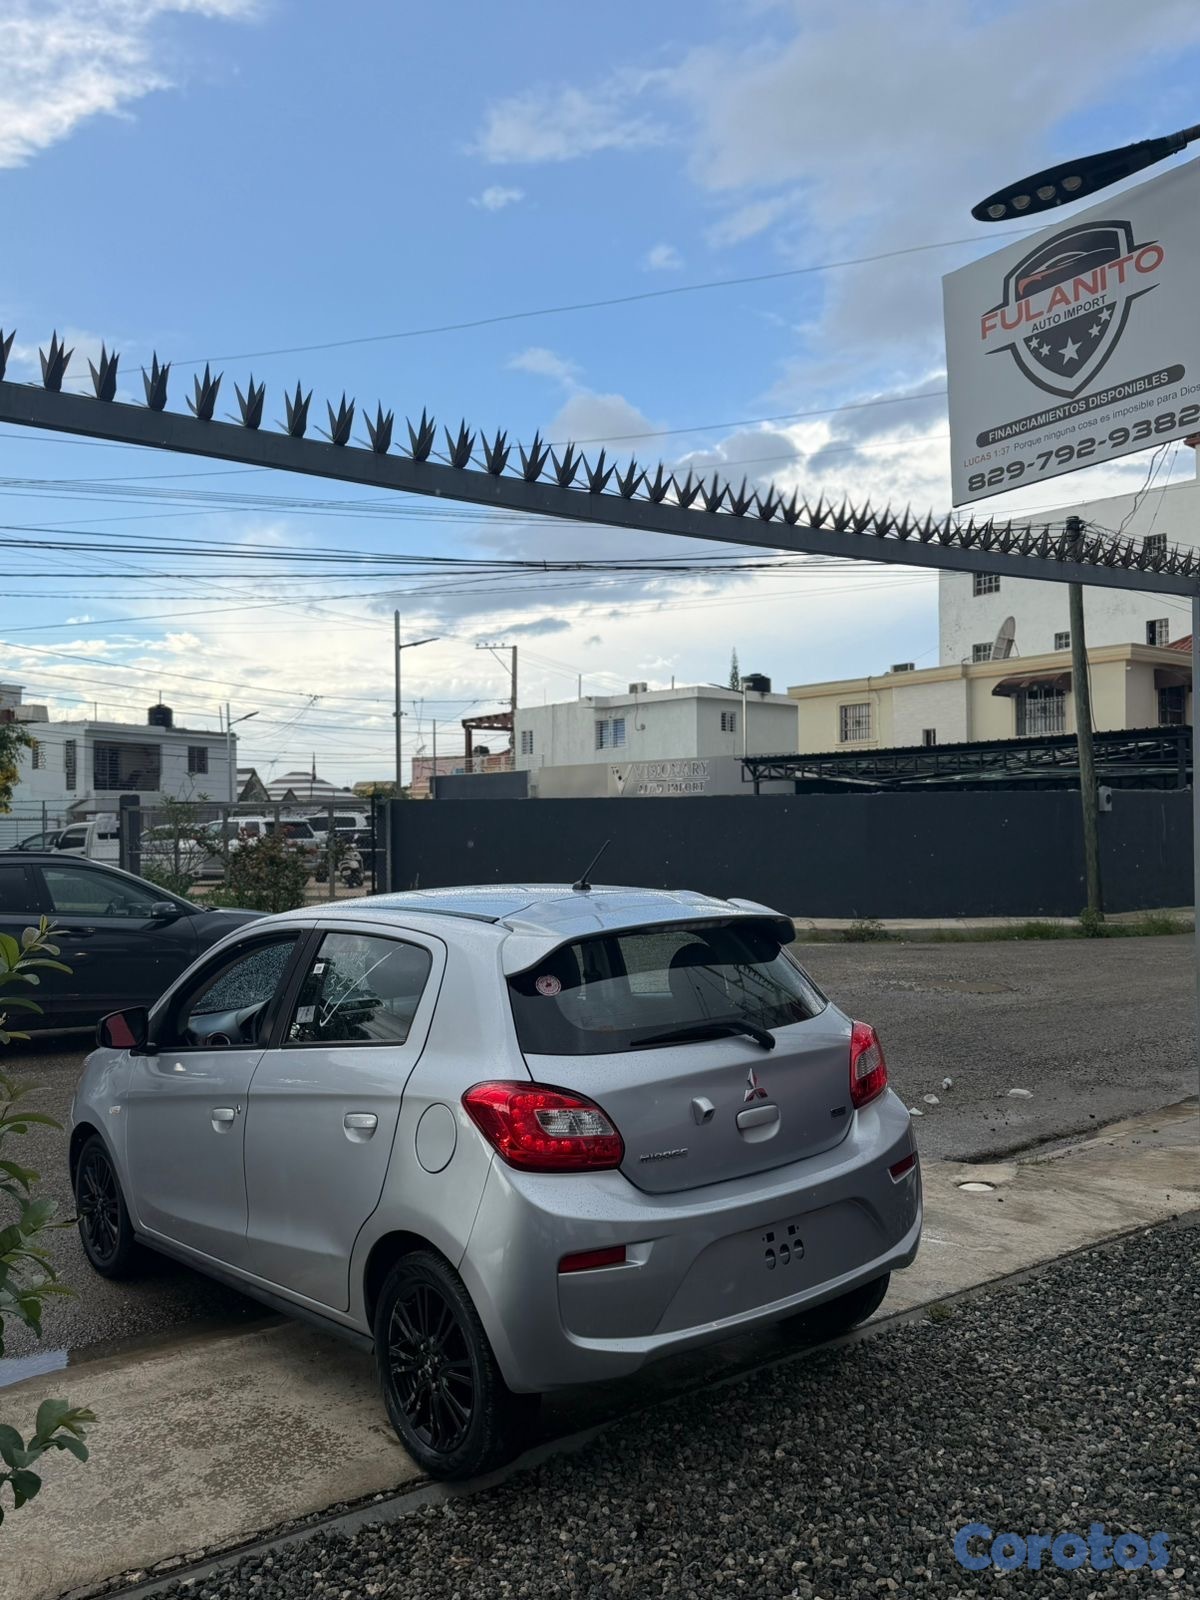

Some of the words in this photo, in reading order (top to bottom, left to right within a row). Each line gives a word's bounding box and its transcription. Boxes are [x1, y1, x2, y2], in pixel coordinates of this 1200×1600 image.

[981, 244, 1164, 340] FULANITO
[1031, 314, 1062, 334] AUTO
[1063, 294, 1107, 321] IMPORT
[963, 451, 993, 468] LUCAS
[994, 445, 1011, 458] 1:37
[1013, 435, 1042, 452] Porque
[1043, 425, 1076, 442] ninguna
[1077, 417, 1098, 431] cosa
[1099, 413, 1111, 424] es
[1112, 399, 1155, 422] imposible
[1156, 391, 1178, 407] para
[988, 401, 1087, 442] FINANCIAMIENTOS
[1089, 371, 1169, 408] DISPONIBLES
[968, 403, 1200, 492] 829-792-9382
[634, 760, 710, 778] VISIONARY
[667, 780, 706, 793] IMPORT
